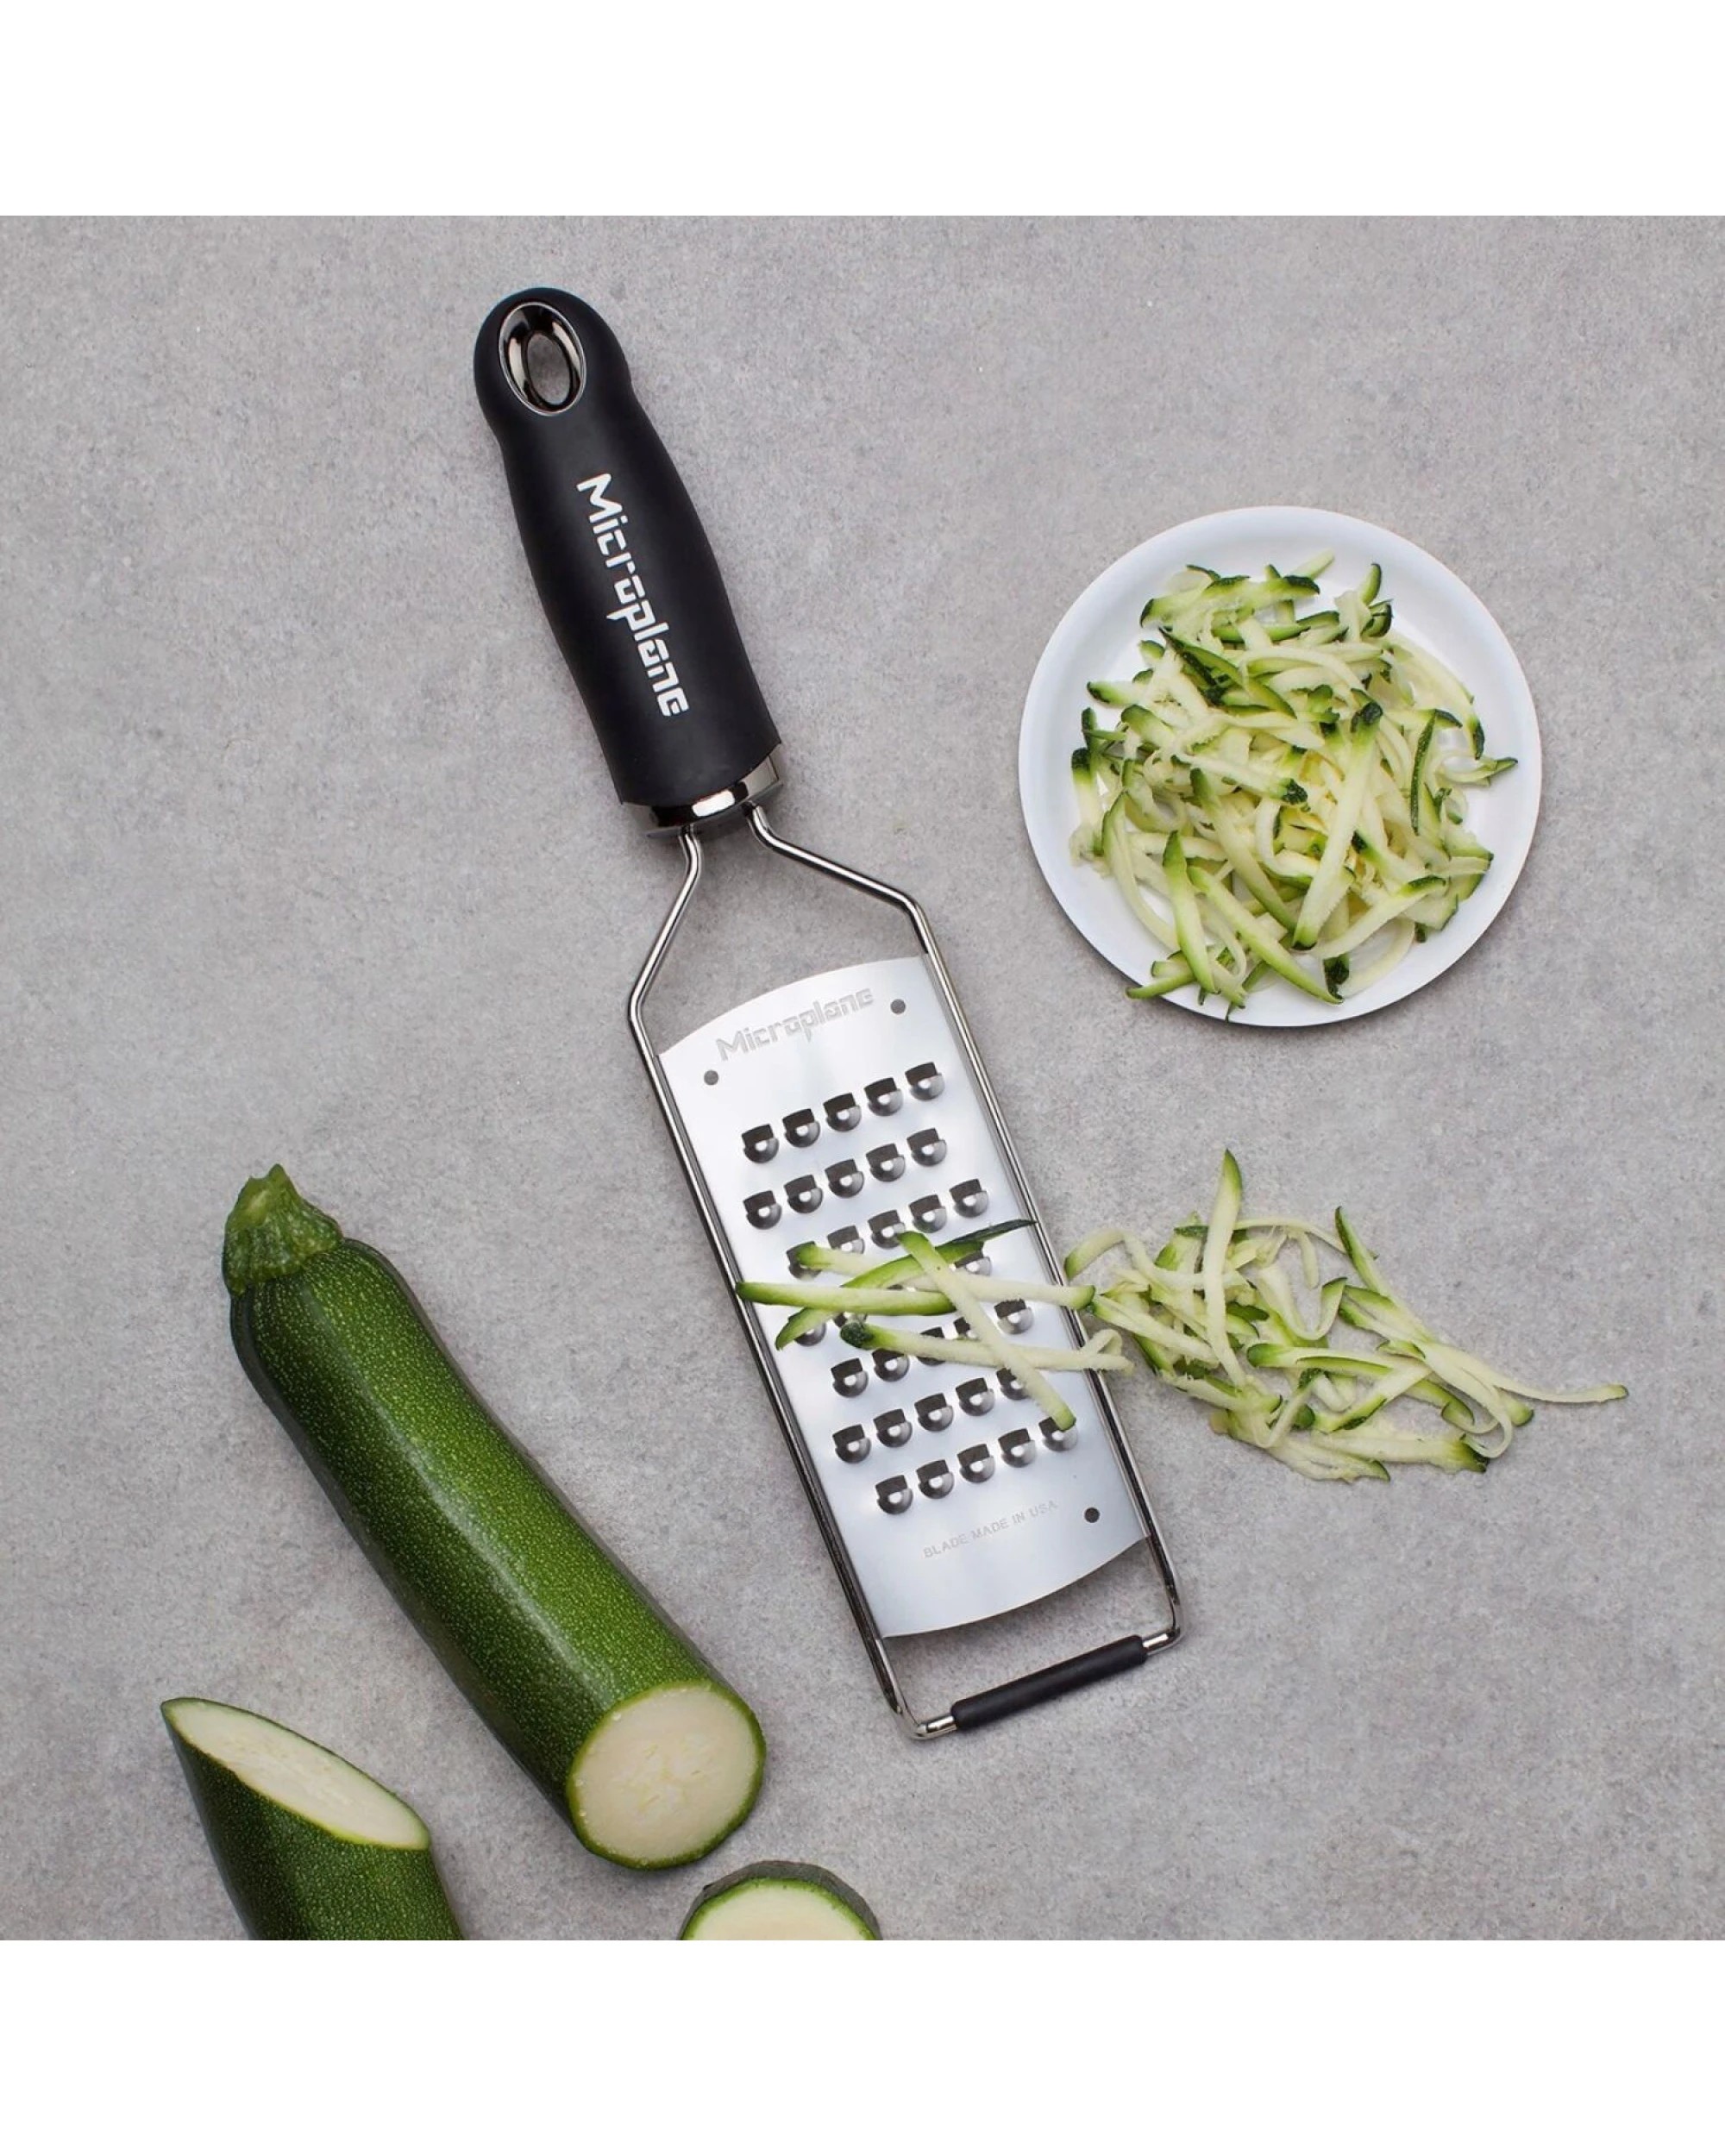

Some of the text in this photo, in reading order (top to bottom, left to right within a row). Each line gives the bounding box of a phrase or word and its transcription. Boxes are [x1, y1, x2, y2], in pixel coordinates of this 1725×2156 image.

[576, 473, 689, 717] Microplane
[716, 988, 874, 1062] Microplane
[923, 1500, 1058, 1558] BLADE MADE IN USA
